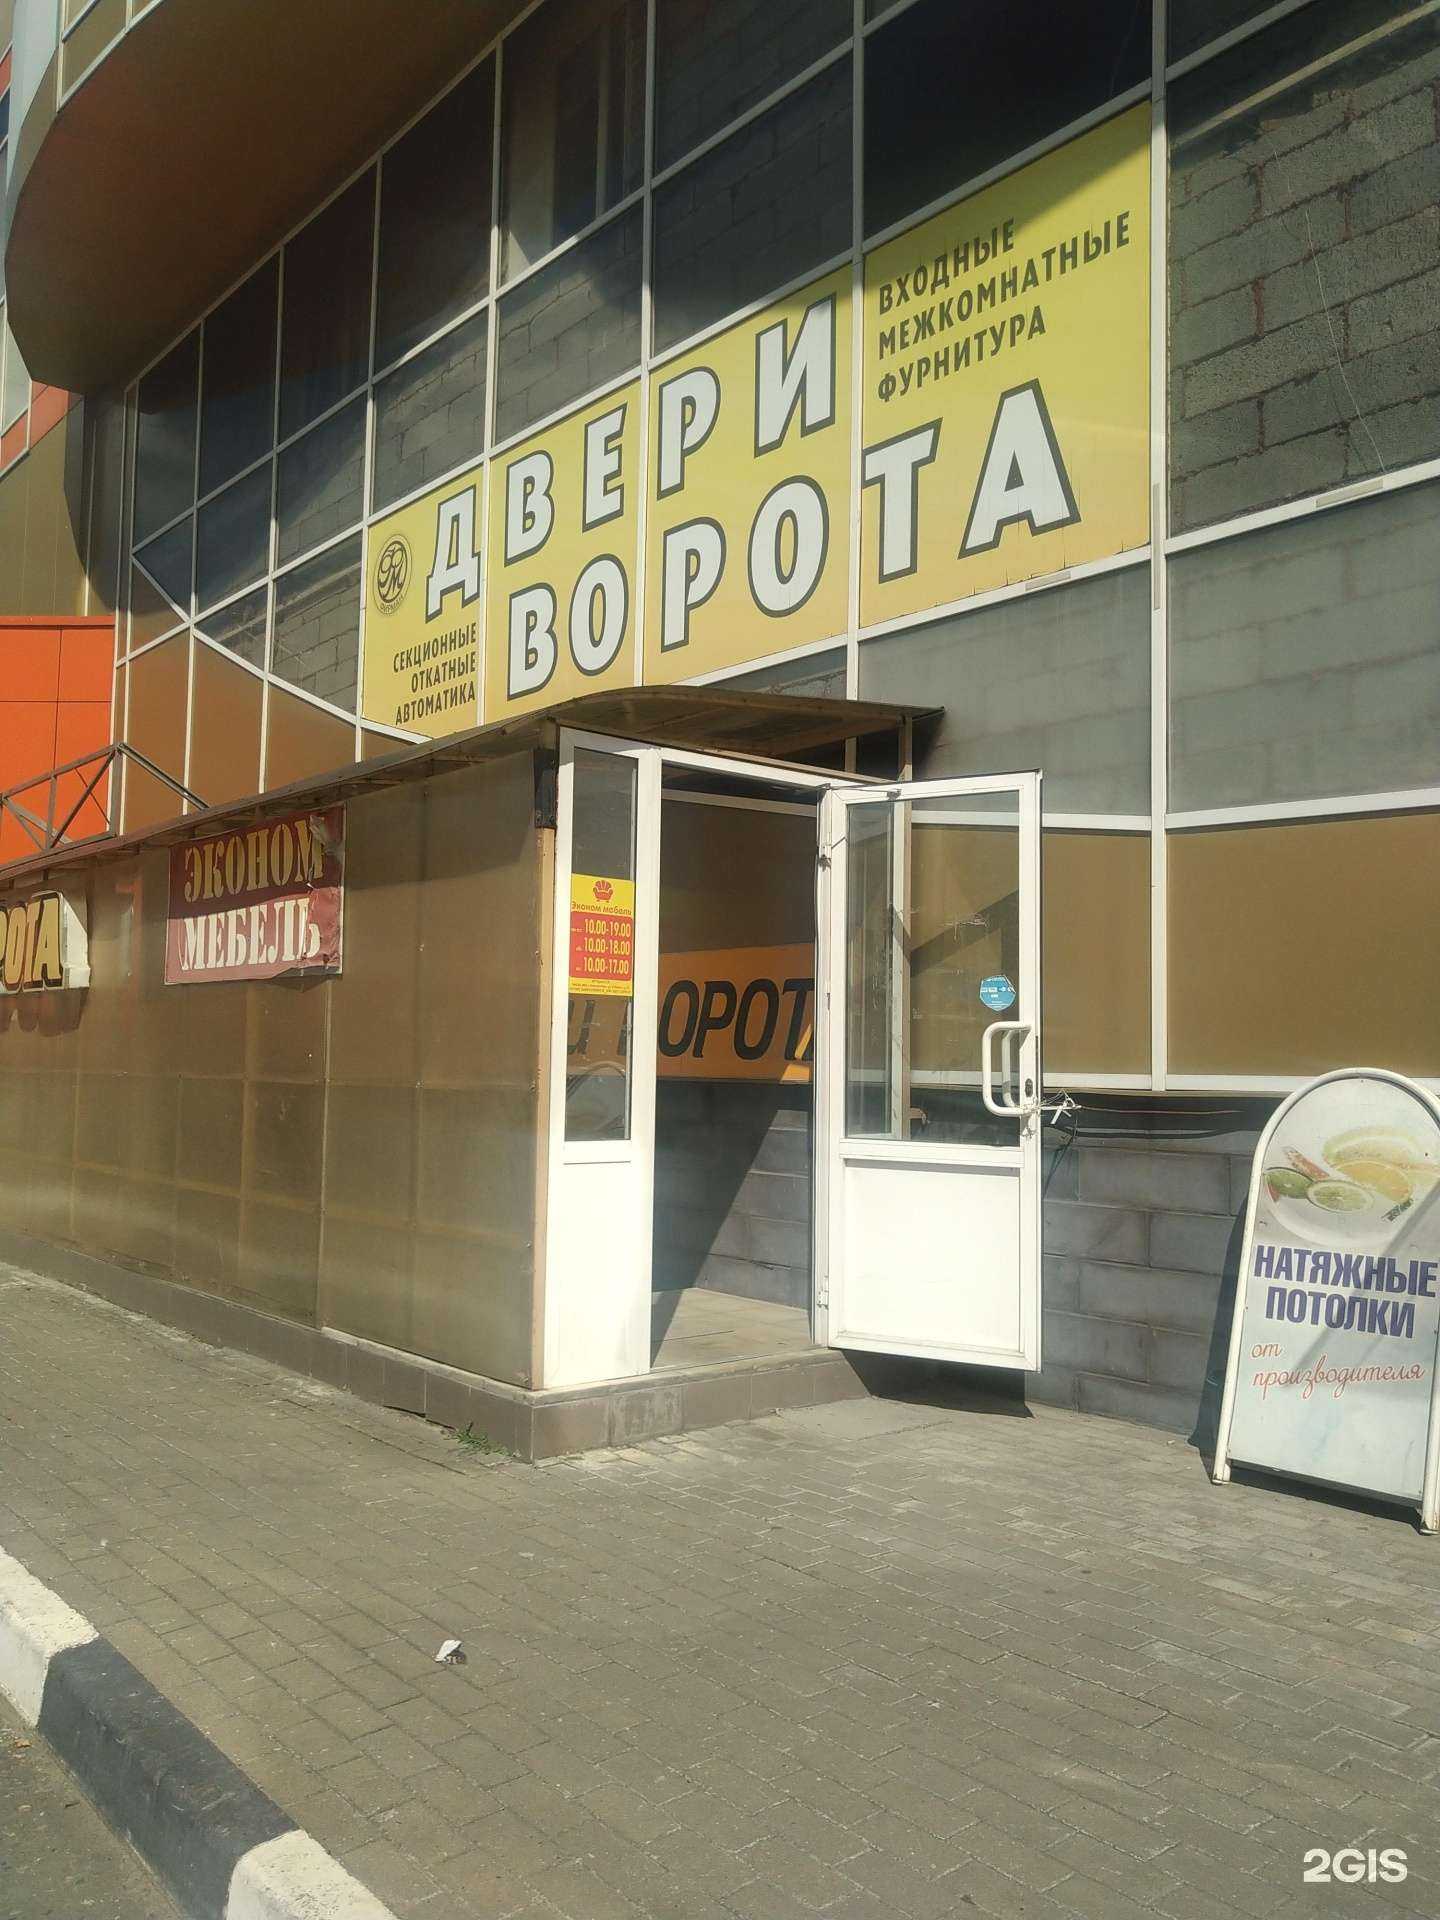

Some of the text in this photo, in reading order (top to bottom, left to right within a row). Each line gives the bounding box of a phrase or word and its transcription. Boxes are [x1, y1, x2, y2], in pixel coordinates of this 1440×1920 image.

[878, 217, 1016, 315] ВХОДНЫЕ
[878, 211, 1131, 360] МЕЖКОМНАТНЫЕ
[877, 305, 1046, 403] ФУРНИТУРА
[425, 292, 837, 624] ДВЕРИ
[507, 378, 1082, 701] ВОРОТА
[393, 622, 477, 673] СЕКЦИОННЫЕ
[411, 651, 477, 693] ОТКАТНЫЕ
[395, 681, 476, 726] АВТОМАТИКА
[184, 817, 324, 902] ЭКОНОМ
[178, 897, 321, 971] МЕБЕЛЬ
[584, 937, 631, 956] 10.00-18.00
[585, 918, 632, 938] 10.00-19.00
[583, 956, 629, 975] 10.00-17.00
[617, 979, 816, 1060] ОРОТ
[1254, 1245, 1438, 1297] НАТЯЖНЫЕ
[1265, 1286, 1416, 1338] ПОТОЛКИ
[1251, 1343, 1282, 1358] от
[1252, 1354, 1425, 1400] производителя
